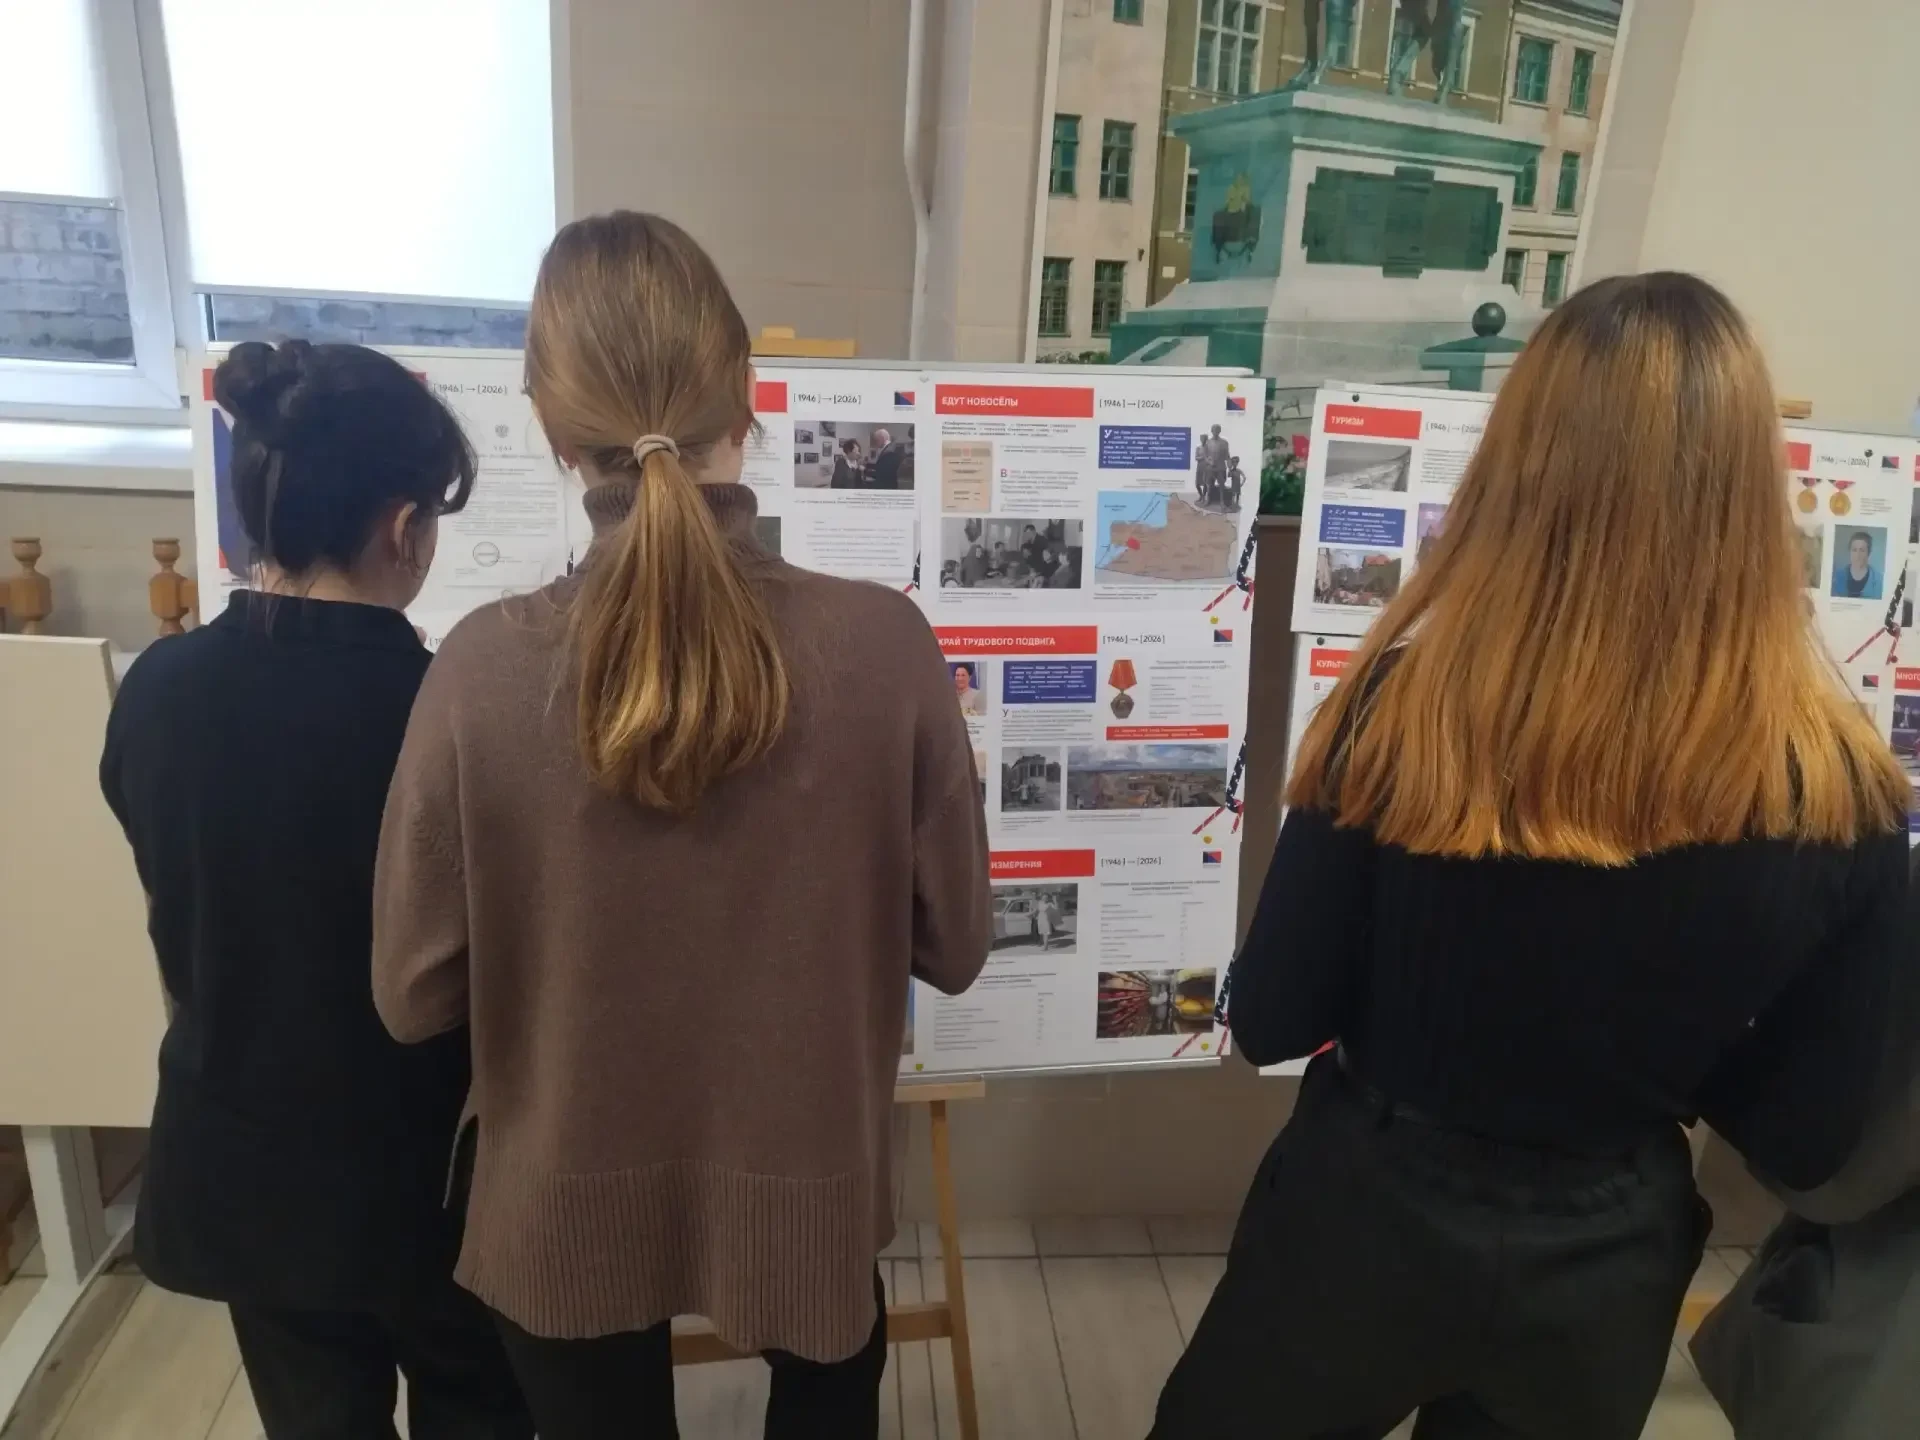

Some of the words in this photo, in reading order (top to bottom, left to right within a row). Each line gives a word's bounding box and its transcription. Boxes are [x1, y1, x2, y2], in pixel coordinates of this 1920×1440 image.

[477, 384, 508, 395] [2026]
[793, 392, 821, 404] [1946]
[833, 393, 861, 405] [2026]
[942, 396, 965, 406] ЕДУТ
[967, 396, 1019, 407] НОВОСЁЛЫ
[1099, 398, 1126, 409] [1946]
[1137, 399, 1164, 410] [2026]
[1330, 415, 1365, 427] ТУРИЗМ
[938, 636, 961, 646] КРАЙ
[962, 636, 1014, 647] ТРУДОВОГО
[1015, 636, 1056, 646] ПОДВИГА
[1102, 634, 1128, 645] [1946]
[1140, 634, 1165, 645] [2026]
[991, 860, 1042, 869] ИЗМЕРЕНИЯ
[1136, 856, 1162, 867] [2026]
